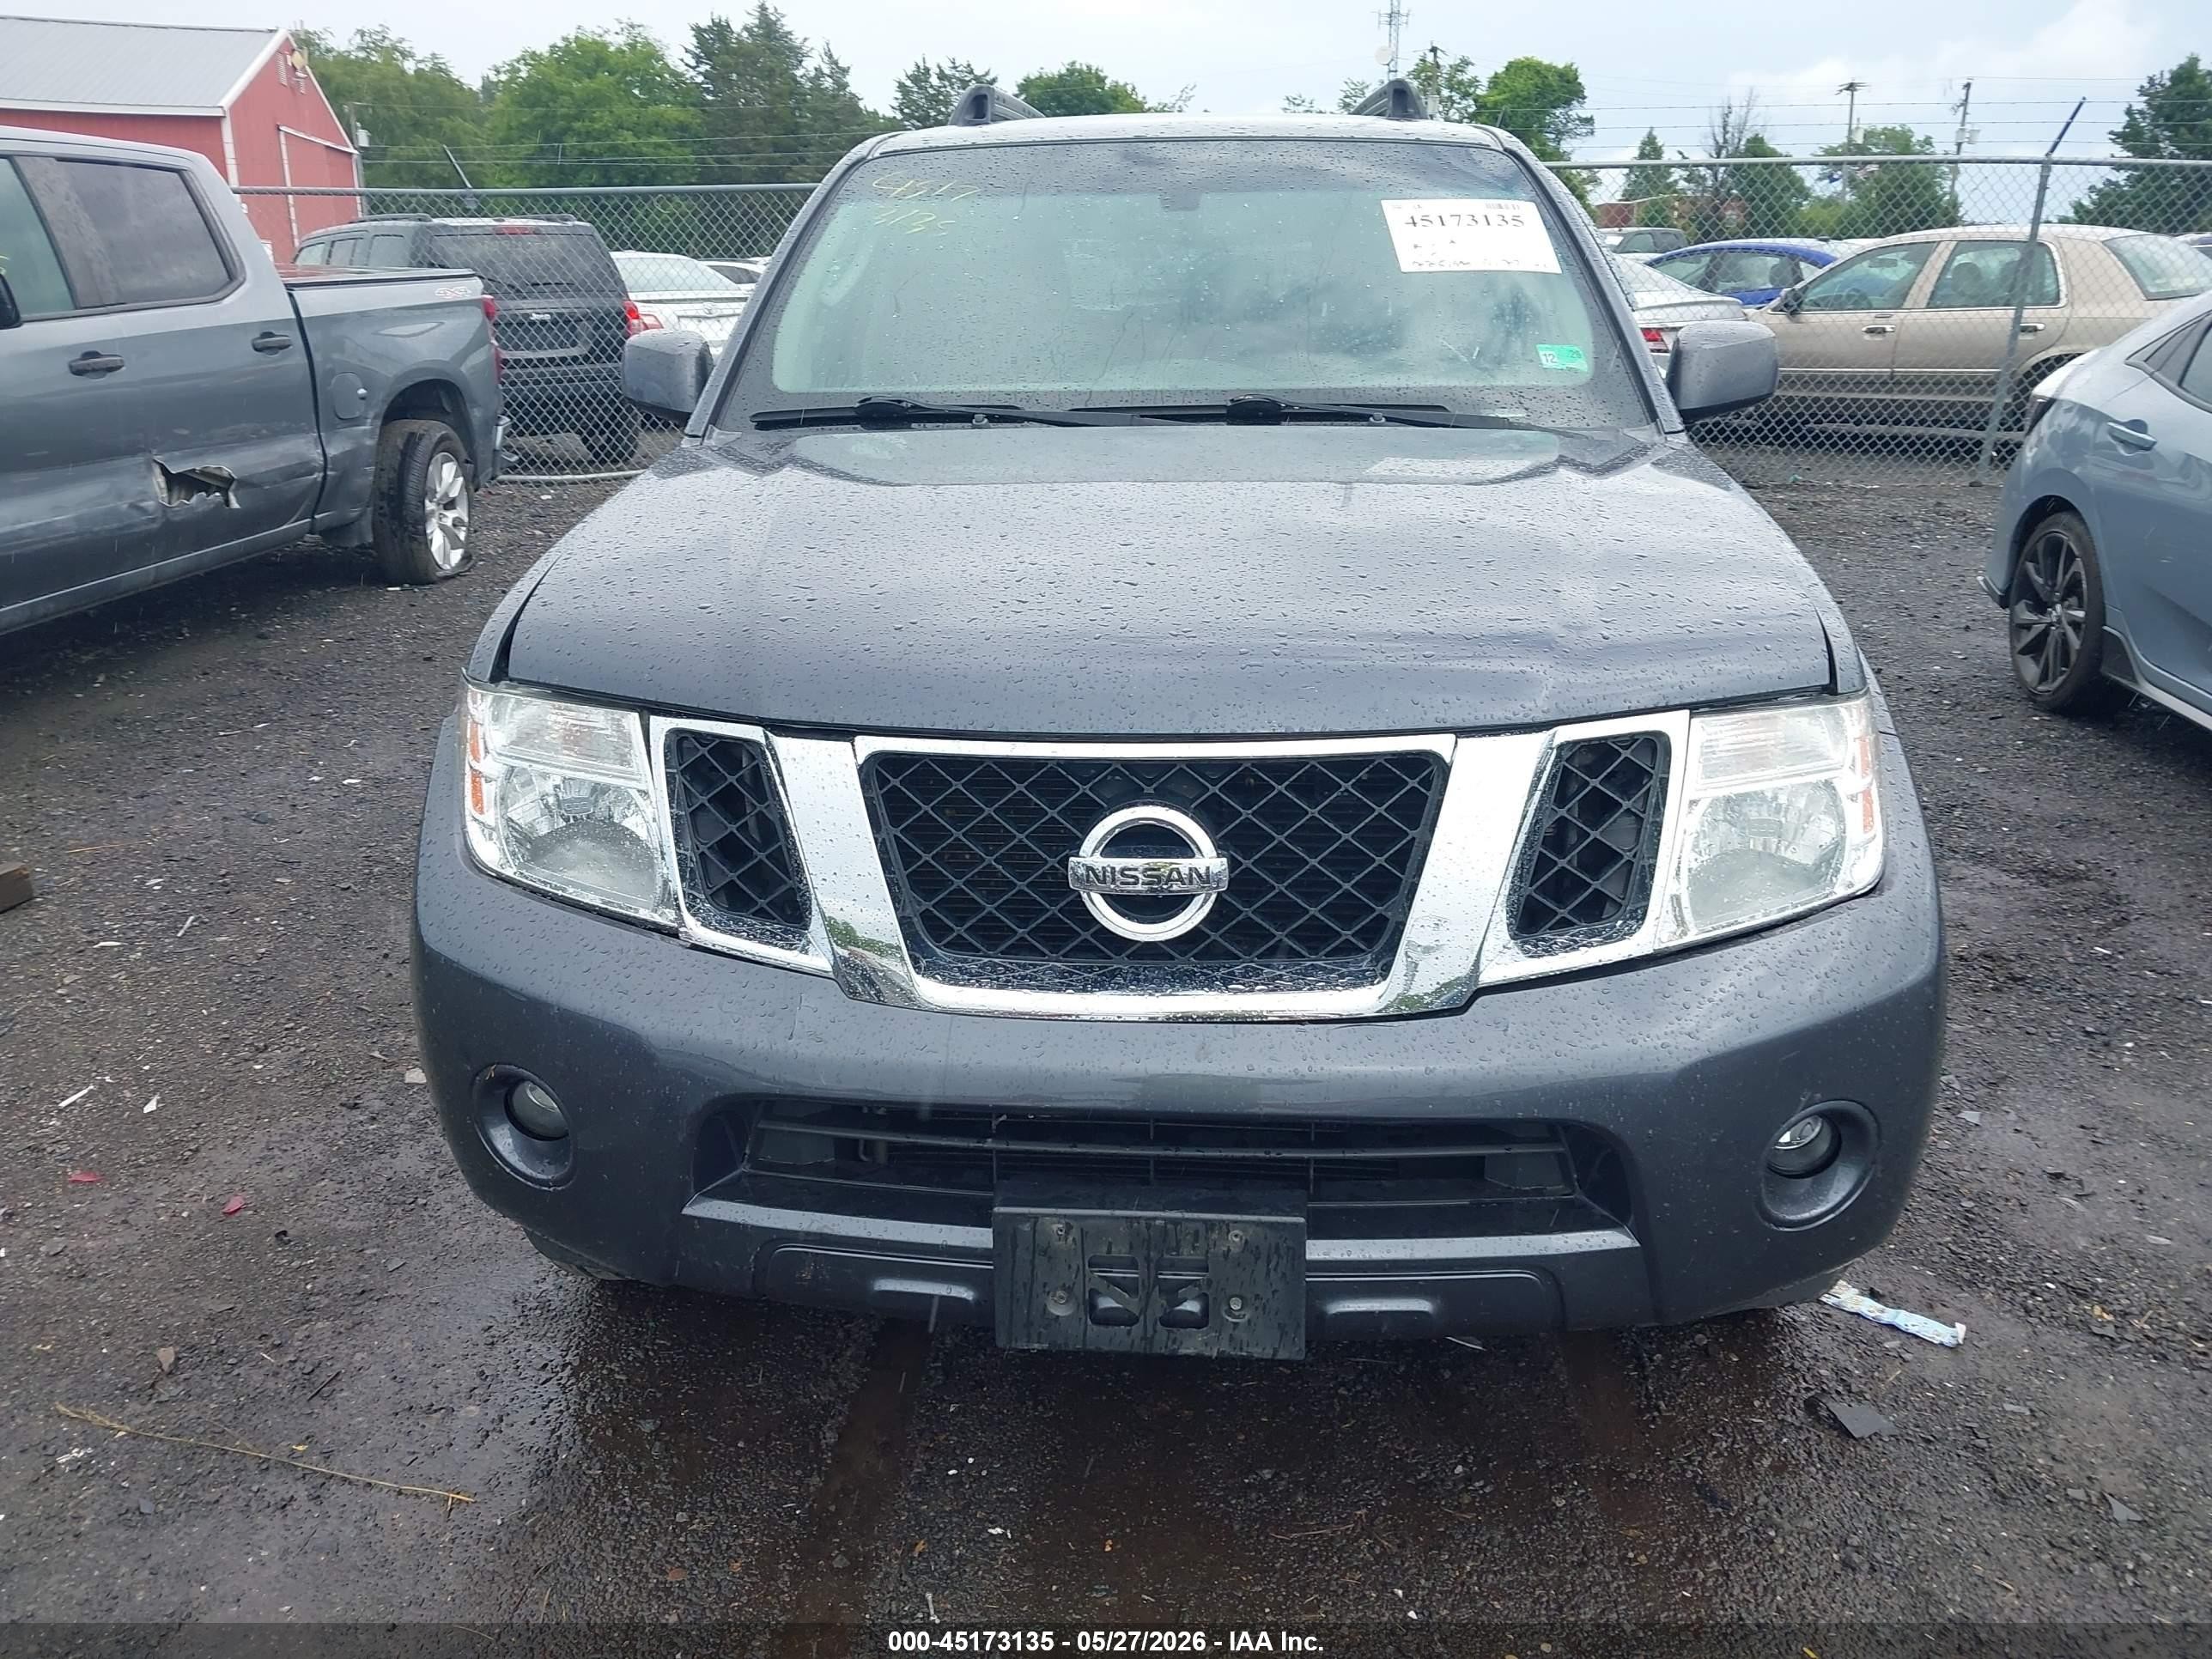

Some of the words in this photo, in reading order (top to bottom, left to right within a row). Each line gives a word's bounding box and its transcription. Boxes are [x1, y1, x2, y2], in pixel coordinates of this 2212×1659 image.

[1405, 215, 1525, 227] 45173135
[1540, 353, 1558, 363] 12
[1085, 866, 1211, 885] NISSAN
